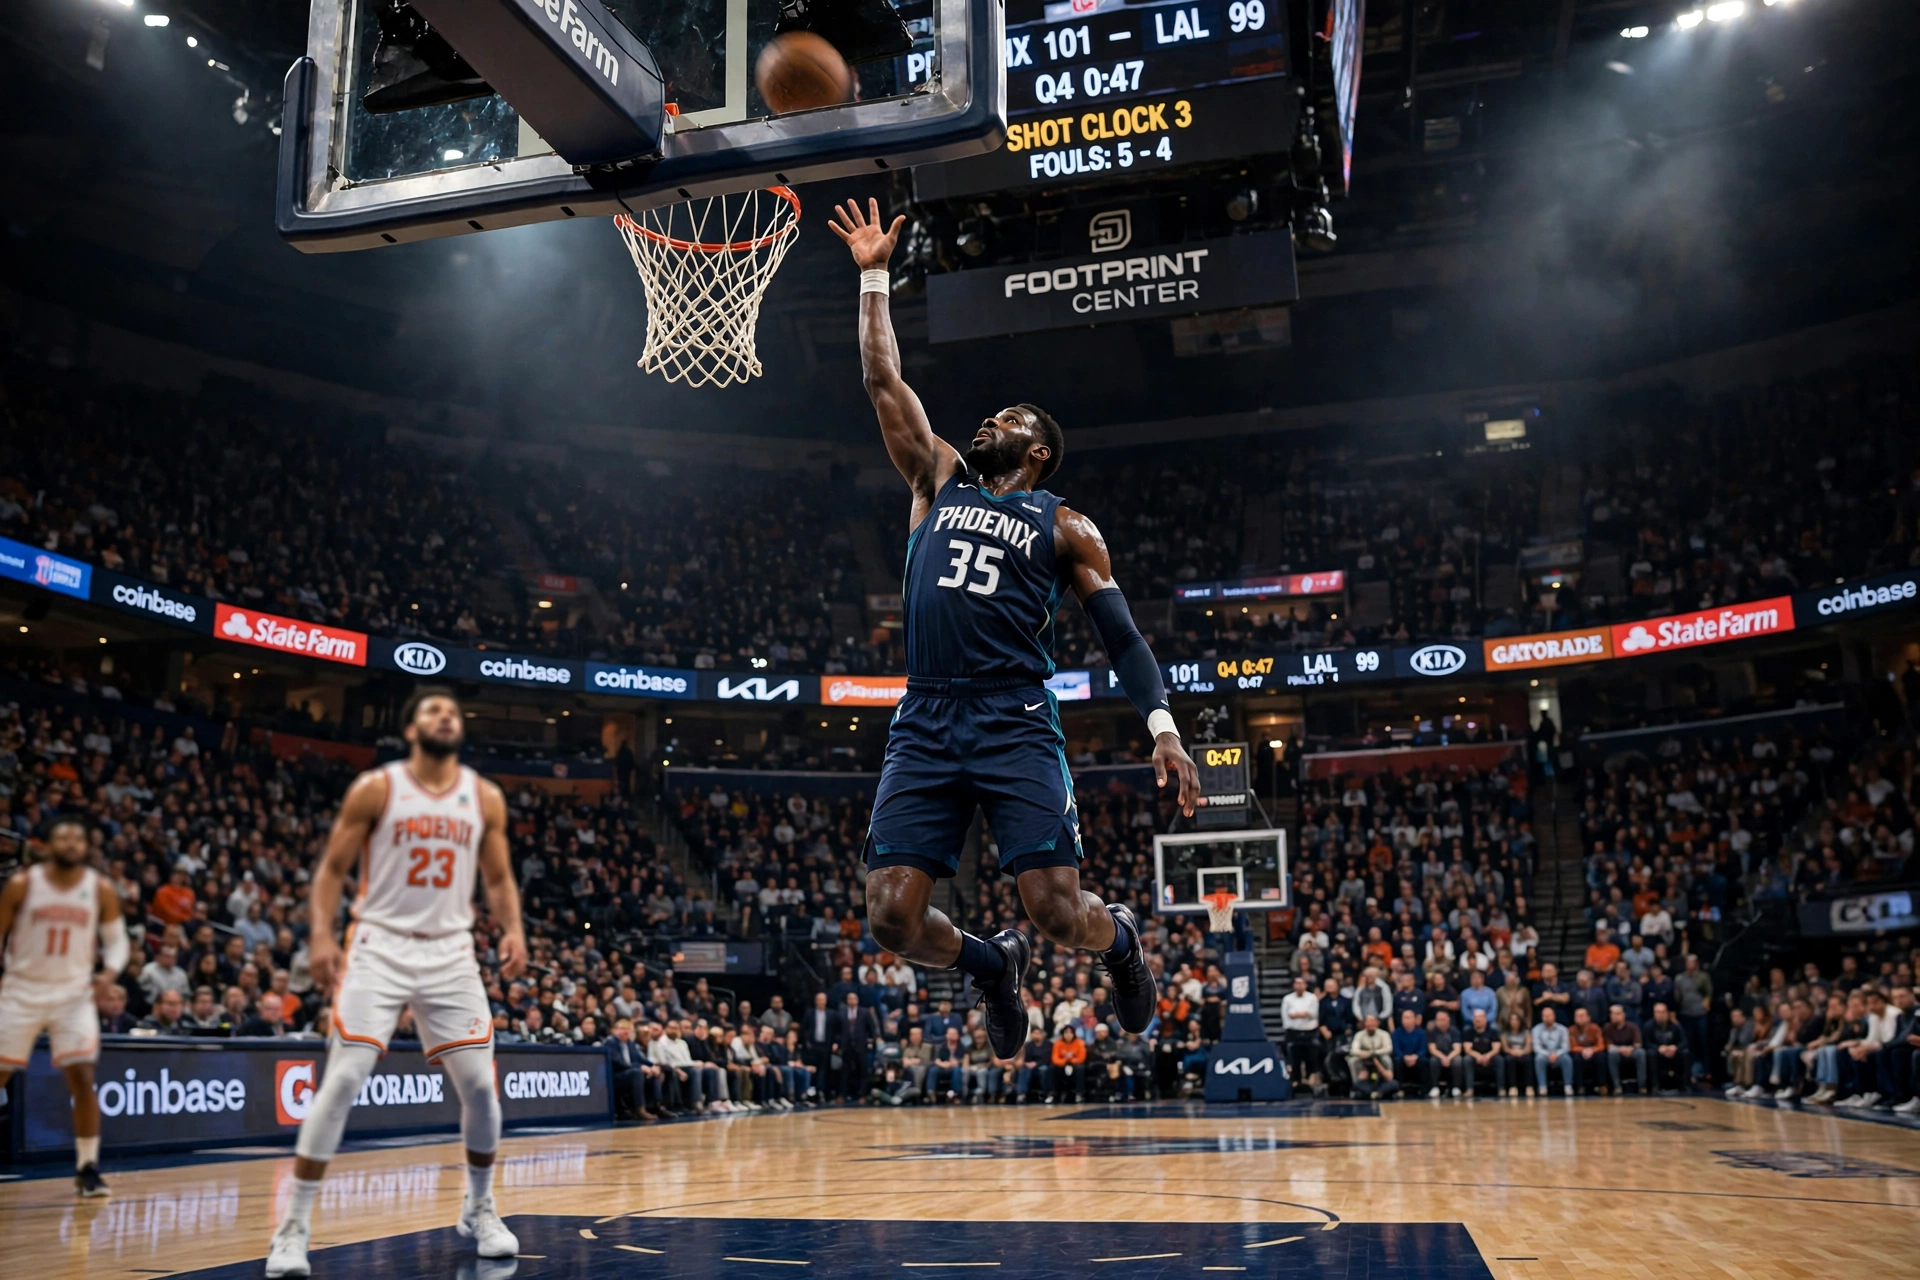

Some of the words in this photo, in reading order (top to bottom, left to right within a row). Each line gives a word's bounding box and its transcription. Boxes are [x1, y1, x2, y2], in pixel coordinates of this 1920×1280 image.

[533, 0, 619, 86] eFarm
[1043, 25, 1091, 60] 101
[1155, 8, 1209, 44] LAL
[1229, 0, 1265, 33] 99
[1035, 71, 1075, 104] Q4
[1083, 60, 1144, 97] 0:47
[1007, 117, 1074, 152] SHOT
[1081, 103, 1169, 141] CLOCK
[1174, 100, 1192, 128] 3
[1030, 145, 1112, 178] FOULS:
[1118, 142, 1133, 167] 5
[1156, 136, 1172, 161] 4
[1005, 249, 1208, 298] FOOTPRINT
[1072, 279, 1199, 313] CENTER
[934, 506, 1039, 559] PHOENIX
[937, 539, 1005, 595] 35
[113, 585, 196, 622] coinbase
[1817, 581, 1917, 615] coinbase
[1242, 657, 1274, 675] 0:47
[1303, 654, 1338, 674] LAL
[1356, 651, 1379, 672] 99
[1492, 635, 1603, 664] GATORADE
[480, 658, 571, 684] coinbase
[594, 668, 687, 693] coinbase
[1169, 663, 1199, 684] 101
[1206, 748, 1241, 767] 0:47
[407, 847, 455, 888] 23
[45, 927, 70, 956] 11
[71, 1068, 246, 1117] oinbase
[352, 1074, 444, 1106] TORADE
[504, 1071, 590, 1099] GATORADE
